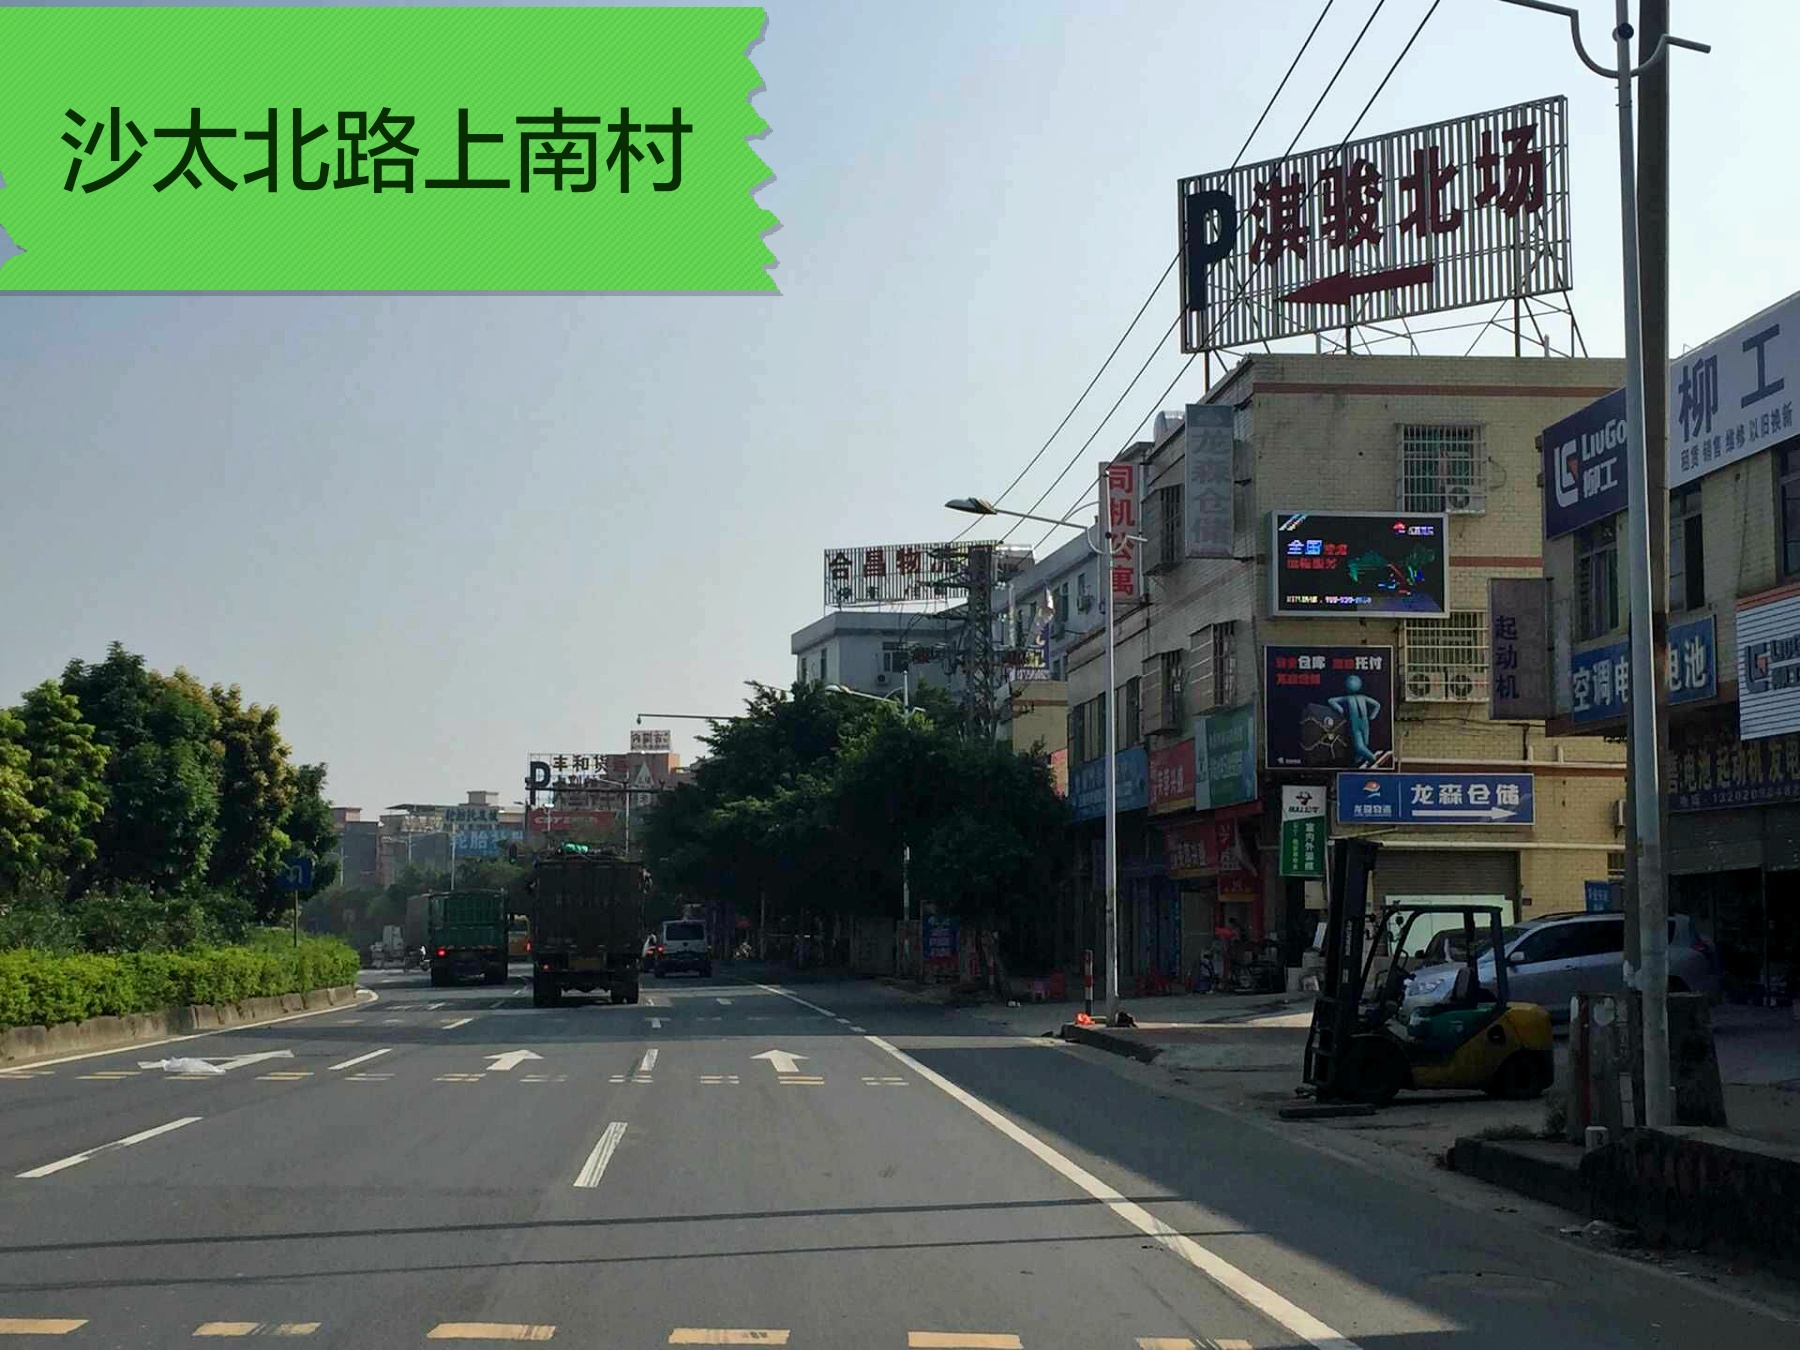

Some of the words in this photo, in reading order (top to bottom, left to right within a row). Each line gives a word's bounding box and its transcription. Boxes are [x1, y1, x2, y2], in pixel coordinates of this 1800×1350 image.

[1248, 123, 1544, 265] 淇骏北场
[1679, 324, 1785, 442] 柳工
[1108, 464, 1136, 596] 司机公寓
[1495, 615, 1520, 699] 起动机
[530, 761, 551, 805] P
